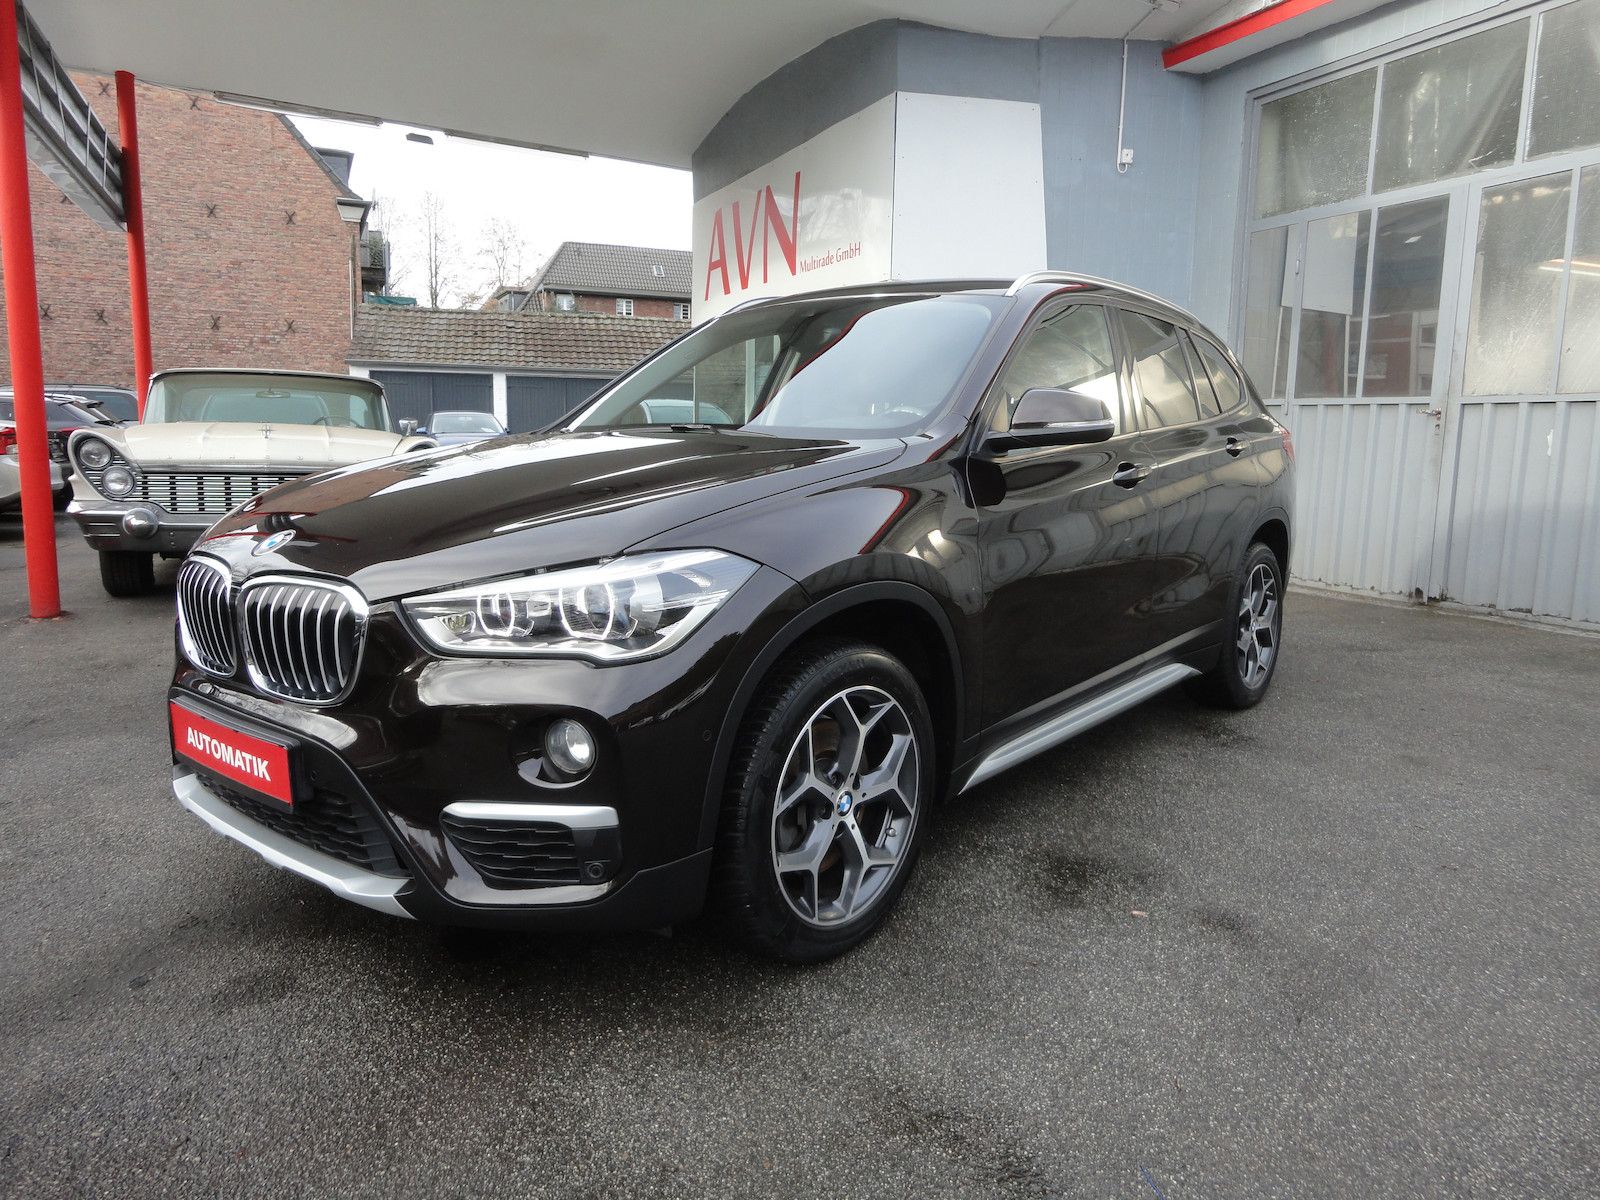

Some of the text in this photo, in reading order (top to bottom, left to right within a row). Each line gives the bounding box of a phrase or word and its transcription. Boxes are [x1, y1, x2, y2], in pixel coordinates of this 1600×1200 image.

[704, 171, 801, 302] AVN
[799, 241, 861, 273] Multirade GmbH
[186, 726, 272, 782] AUTOMATIK
